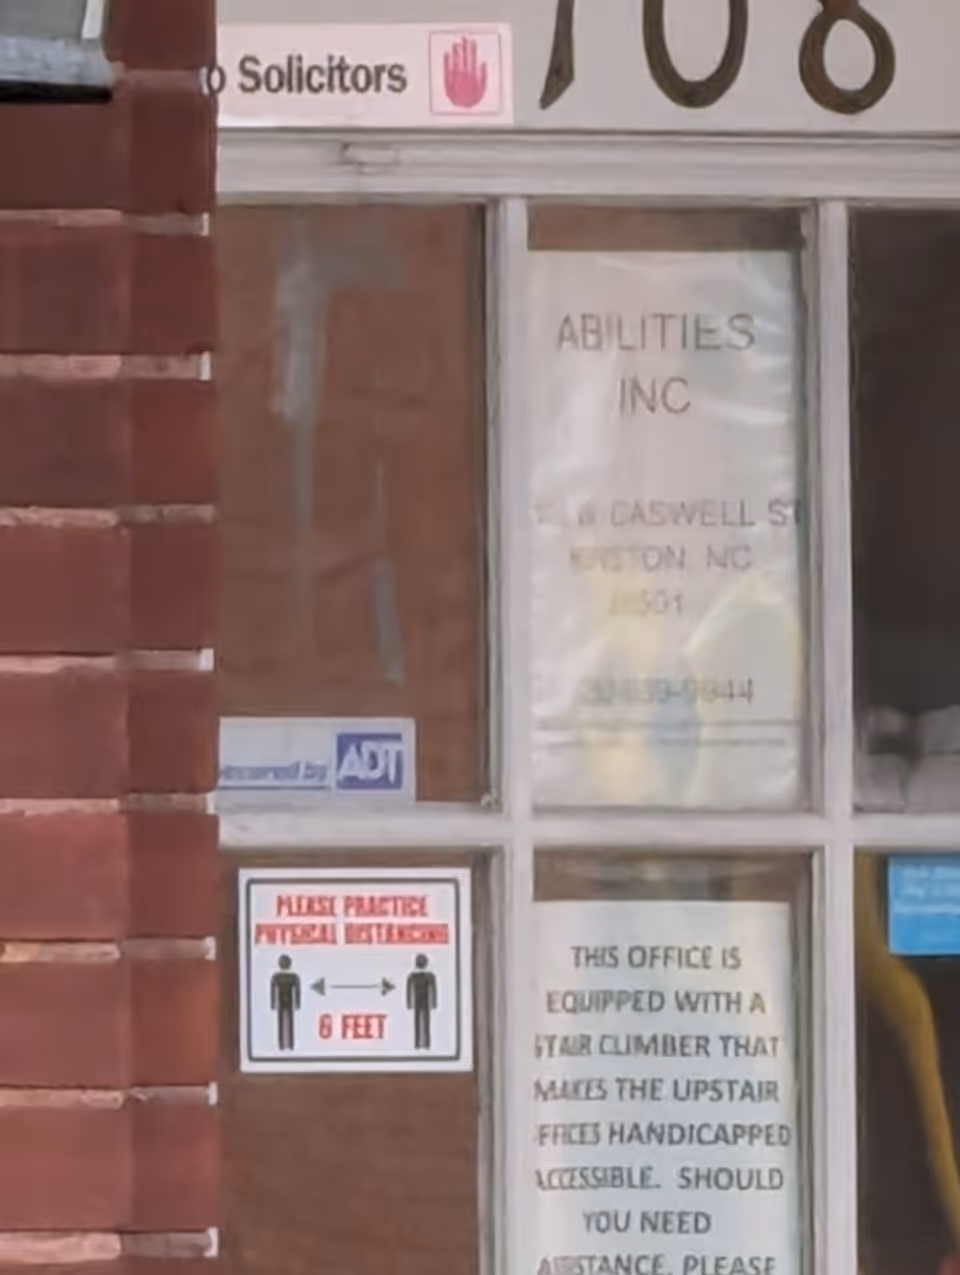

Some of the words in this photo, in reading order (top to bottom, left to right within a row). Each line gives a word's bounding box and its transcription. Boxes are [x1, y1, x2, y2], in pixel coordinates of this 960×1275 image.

[238, 54, 408, 95] Solicitors
[557, 313, 756, 351] ABILITIES
[619, 377, 691, 414] INC
[611, 500, 756, 528] CASWELL
[706, 546, 752, 571] NC
[337, 739, 405, 785] ADT
[277, 894, 337, 917] PLEASE
[344, 894, 429, 917] PRACTICE
[571, 945, 619, 969] THIS
[627, 945, 713, 970] OFFICE
[721, 946, 742, 970] IS
[546, 989, 666, 1015] EQUIPPED
[674, 990, 743, 1014] WITH
[749, 991, 767, 1014] A
[318, 1013, 333, 1039] 6
[341, 1013, 388, 1039] FEET
[599, 1033, 711, 1057] CLIMBER
[719, 1034, 780, 1057] THAT
[534, 1077, 608, 1101] MAKES
[615, 1077, 664, 1101] THE
[673, 1078, 780, 1102] UPSTAIR
[537, 1122, 600, 1146] FFICES
[608, 1121, 792, 1146] HANDICAPPED
[677, 1166, 784, 1191] SHOULD
[583, 1209, 631, 1234] YOU
[640, 1209, 713, 1234] NEED
